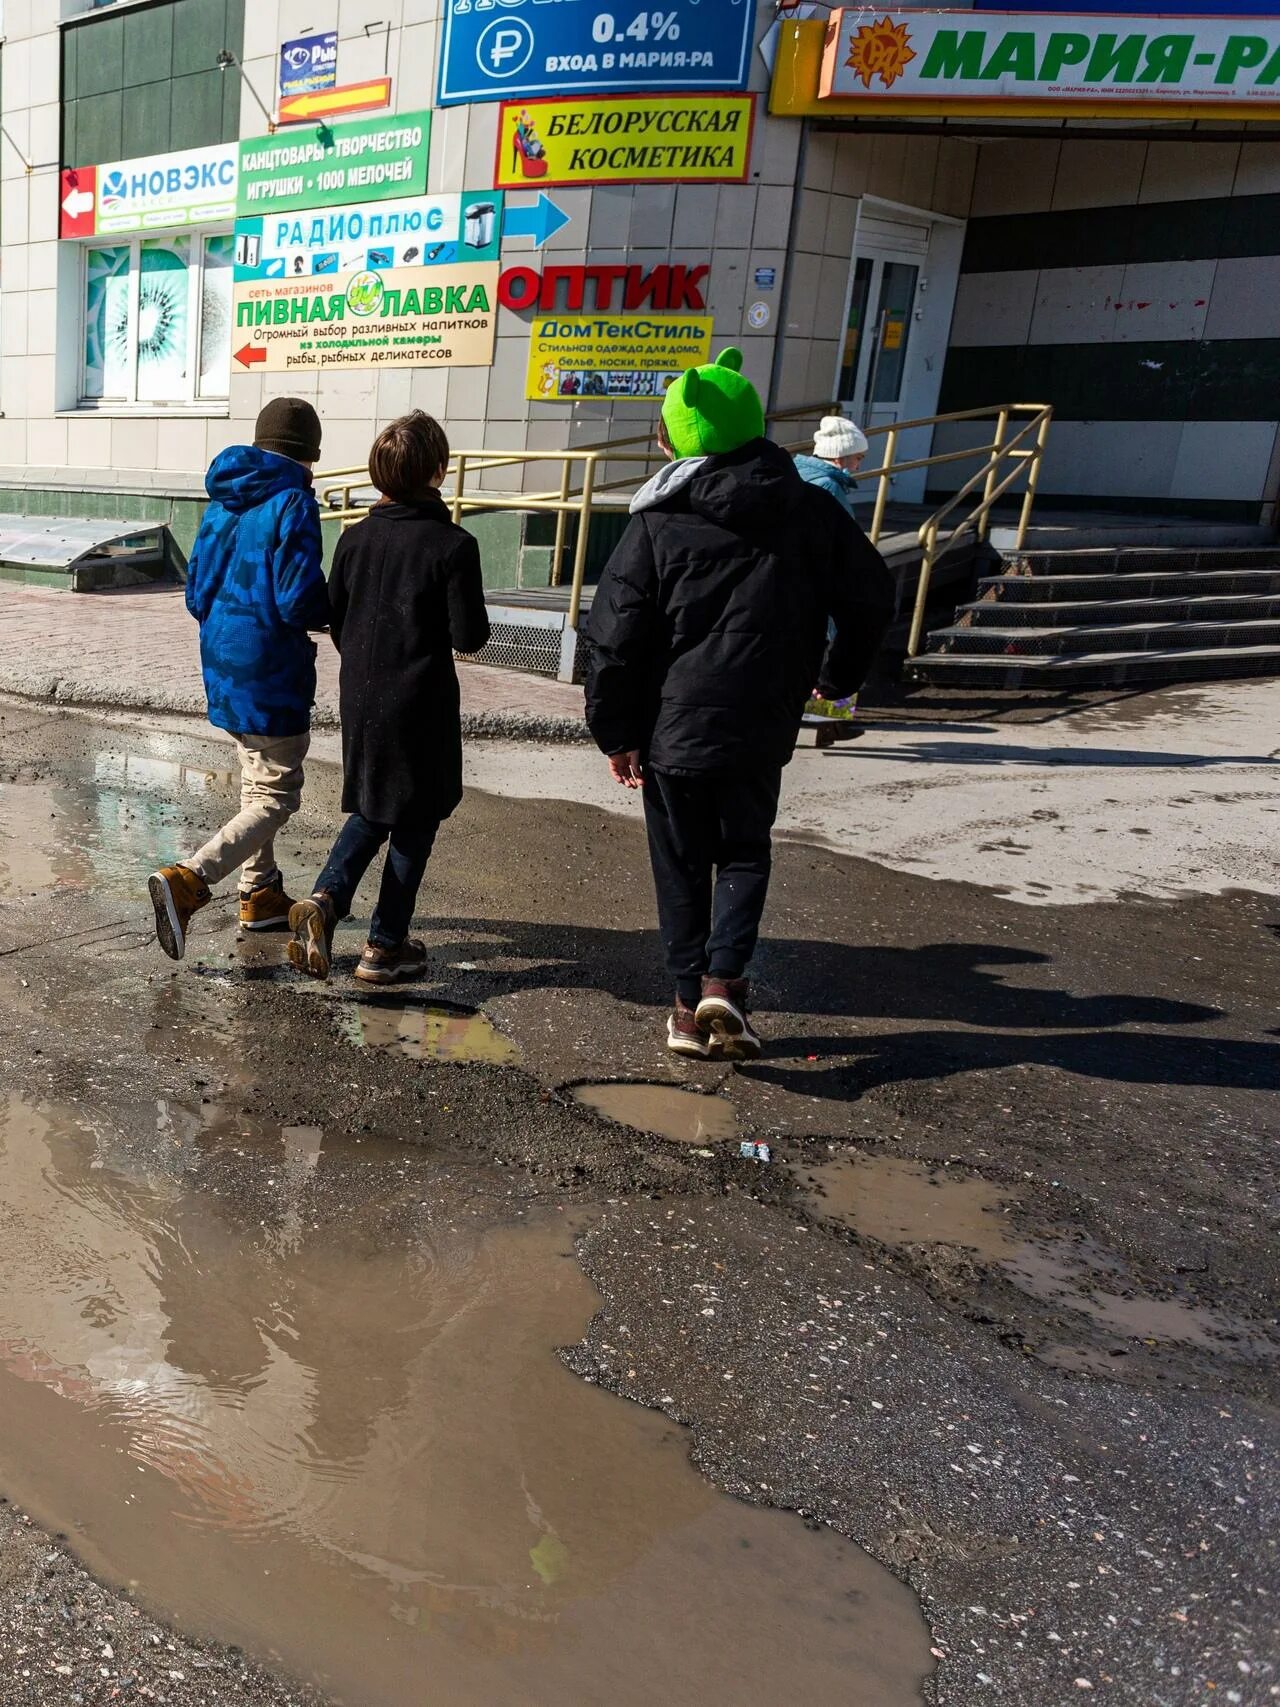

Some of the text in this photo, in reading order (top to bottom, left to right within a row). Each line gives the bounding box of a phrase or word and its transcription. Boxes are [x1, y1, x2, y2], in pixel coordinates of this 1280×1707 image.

[592, 11, 681, 43] 0.4%
[545, 51, 714, 73] ВХОД В МАРИЯ-РА
[547, 110, 741, 137] БЕЛОРУССКАЯ
[242, 127, 422, 172] КАНЦТОВАРЫ ТВОРЧЕСТВО
[568, 146, 734, 170] КОСМЕТИКА
[131, 159, 235, 198] НОВЭКС
[247, 157, 413, 200] ИГРУШКИ 1000 МЕЛОЧЕЙ
[277, 213, 364, 248] РАДИО
[248, 283, 333, 298] сеть магазинов
[497, 264, 712, 311] ОПТИК
[237, 284, 490, 327] ПИВНАЯ ЛАВКА
[253, 319, 488, 341] Огромный выбор разливных напитков
[315, 335, 389, 350] холодильной
[538, 321, 705, 339] ДомТекСтиль
[370, 348, 453, 362] деликатесов
[538, 343, 703, 355] Стильная одежда для дома,
